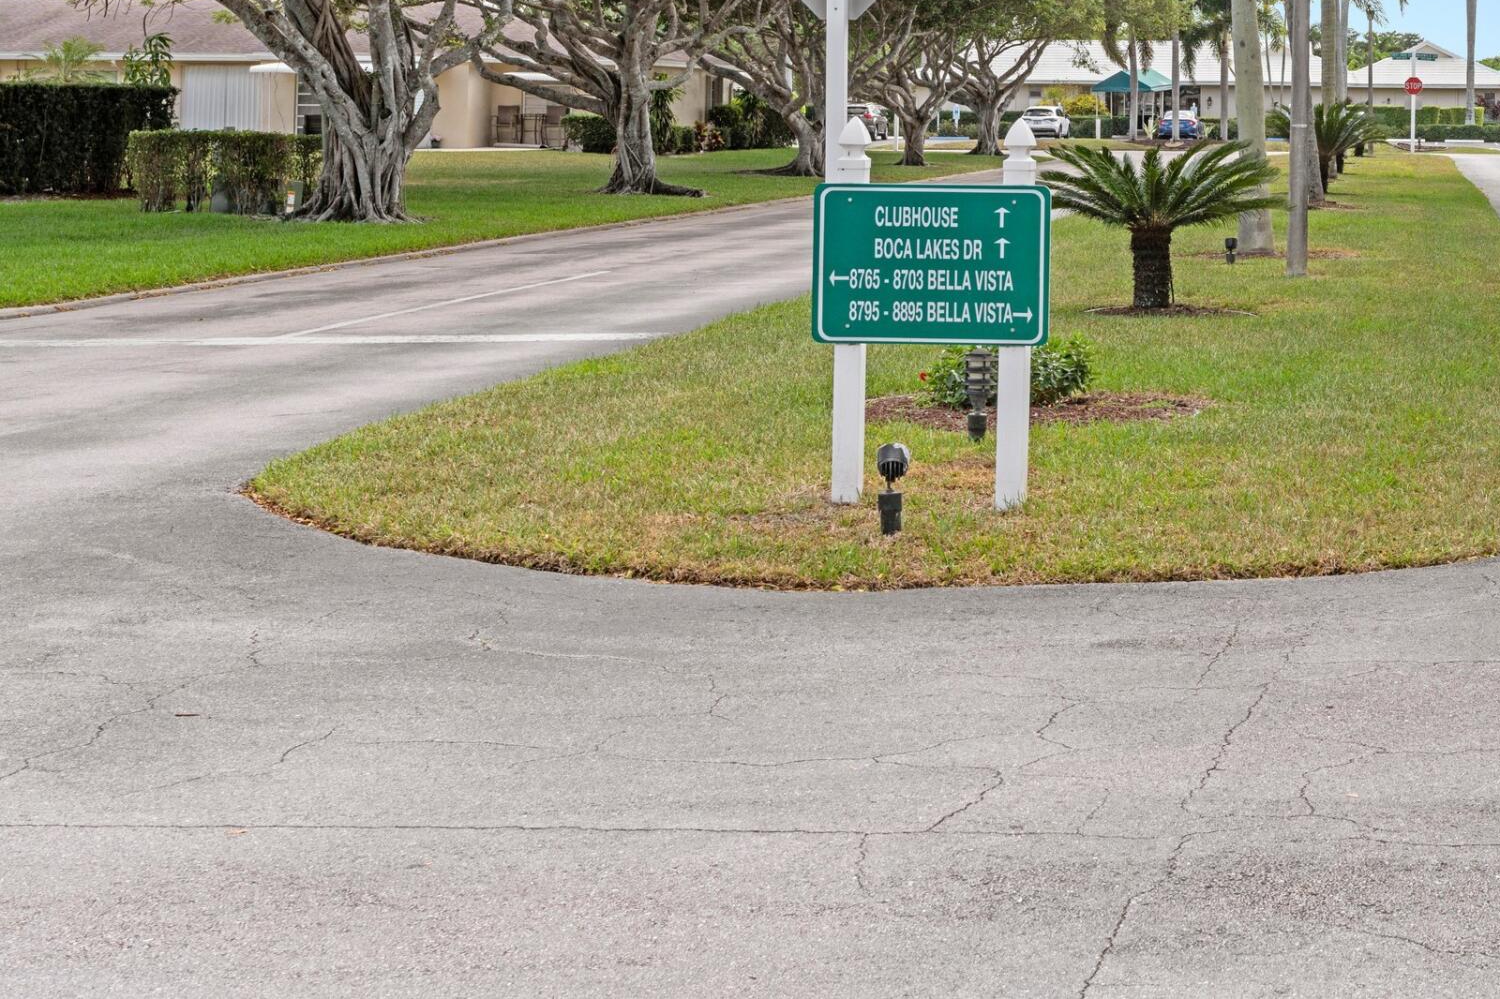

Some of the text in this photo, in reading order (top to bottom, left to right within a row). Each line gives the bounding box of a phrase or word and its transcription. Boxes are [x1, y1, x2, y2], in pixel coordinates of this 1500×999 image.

[1405, 82, 1422, 90] STOP
[875, 206, 959, 228] CLUBHOUSE
[874, 237, 982, 260] BOCA LAKES DR
[849, 268, 880, 290] 8765
[893, 269, 924, 290] 8703
[928, 270, 971, 291] BELLA
[975, 270, 1013, 292] VISTA
[848, 300, 880, 322] 8795
[892, 301, 923, 323] 8895
[927, 302, 970, 323] BELLA
[975, 302, 1013, 324] VISTA
